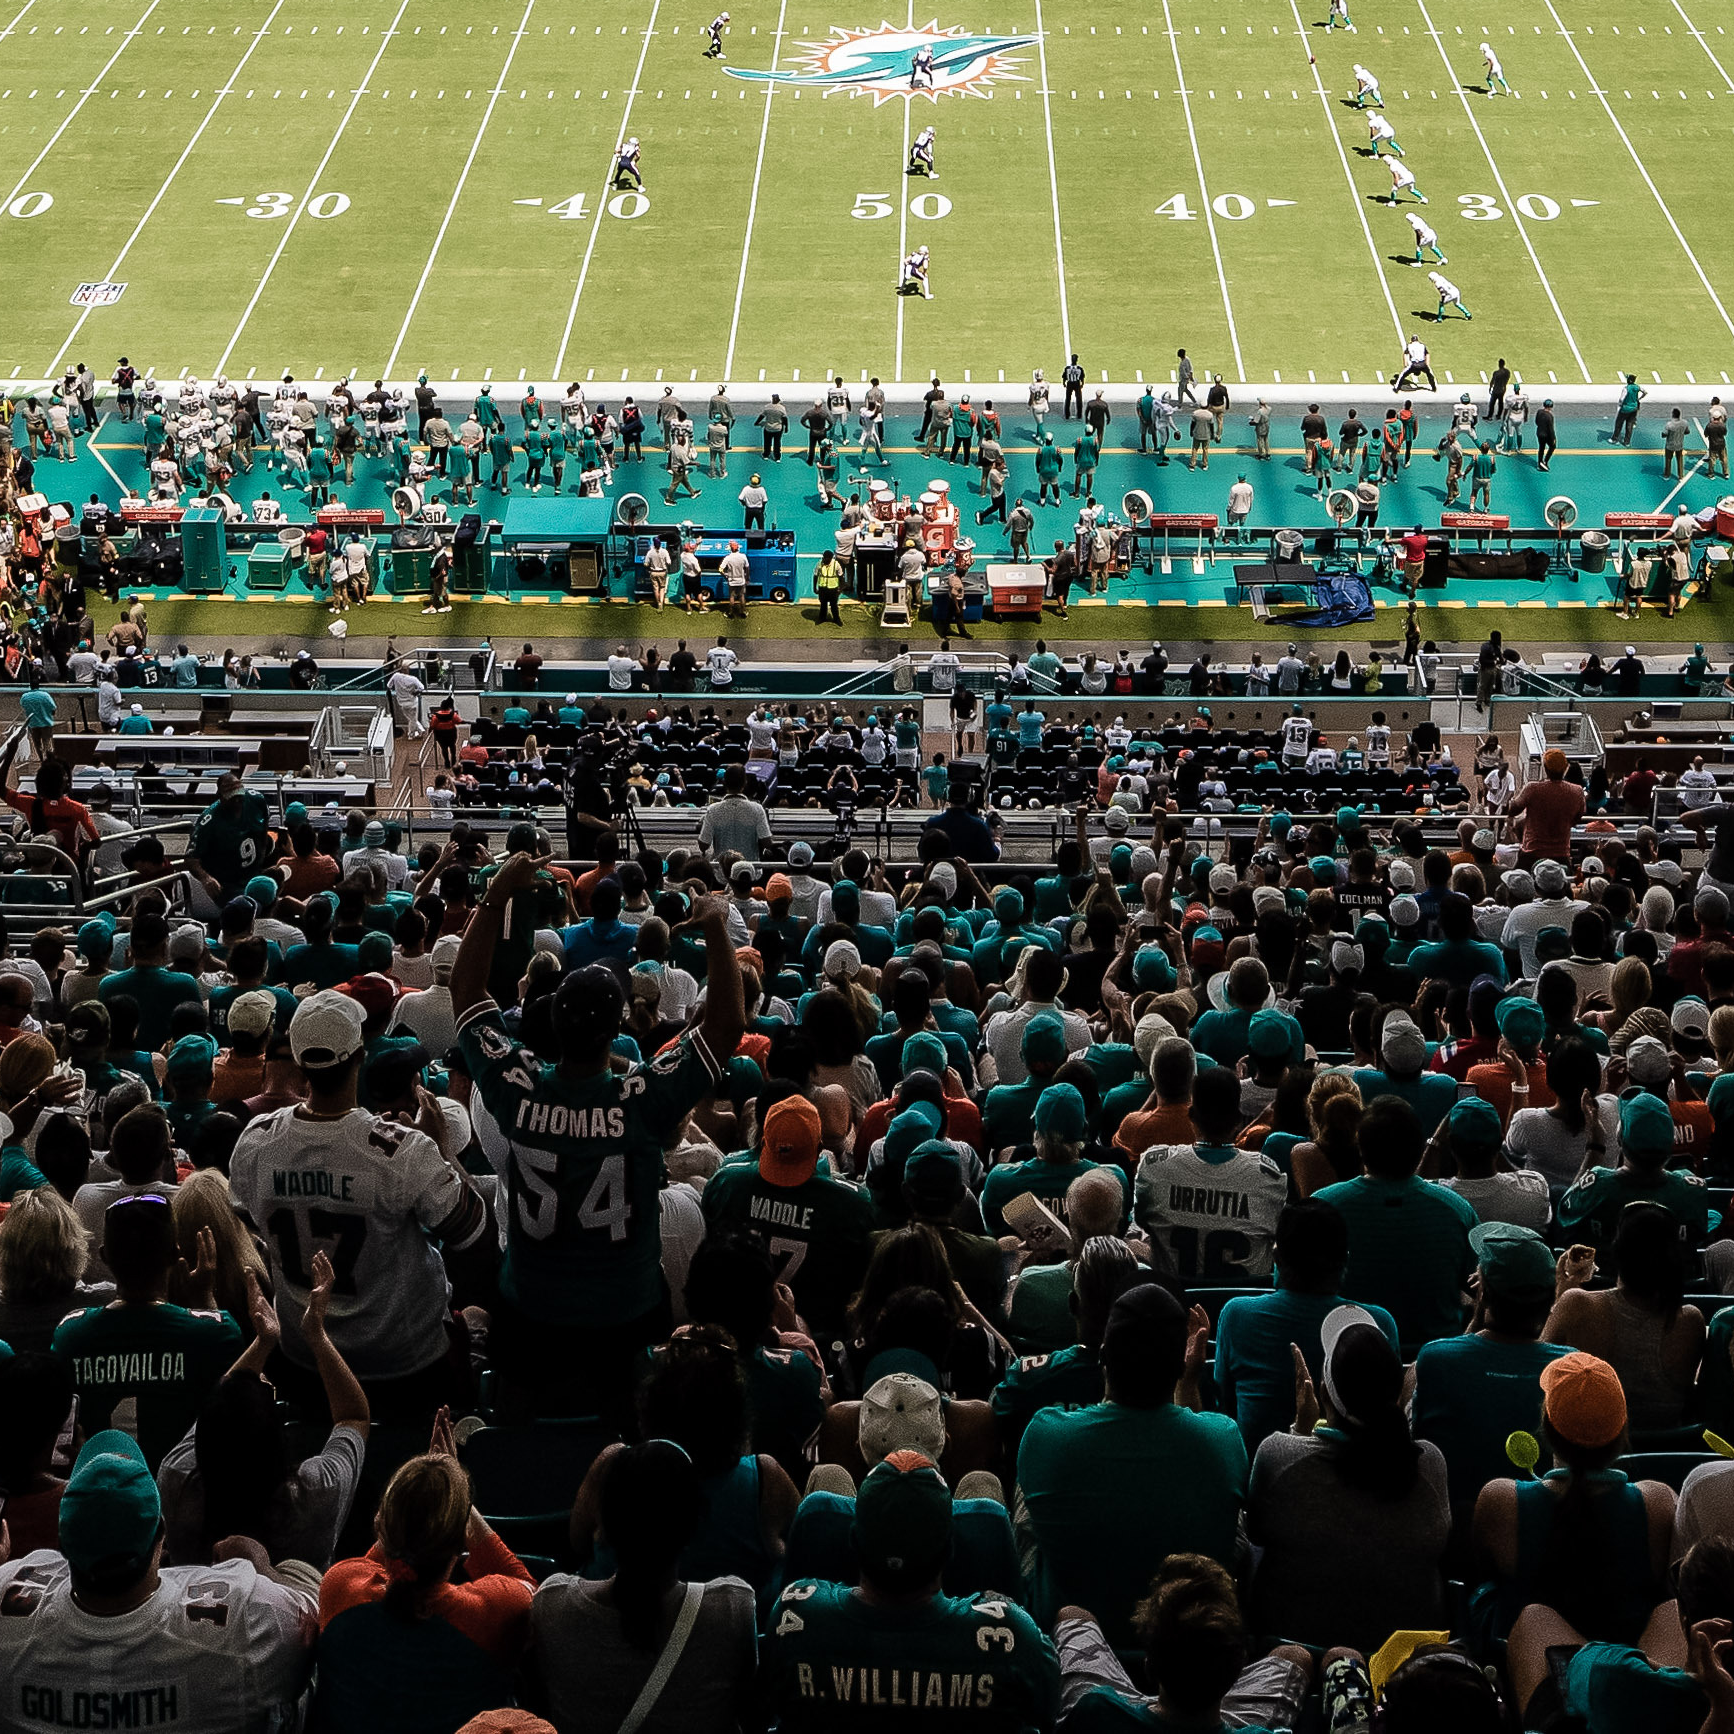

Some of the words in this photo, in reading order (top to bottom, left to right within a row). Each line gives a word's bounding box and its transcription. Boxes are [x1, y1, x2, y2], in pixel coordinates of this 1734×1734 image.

[245, 192, 352, 220] 30
[545, 192, 651, 221] 40
[849, 192, 953, 221] 50
[1153, 193, 1256, 221] 40
[1456, 193, 1562, 221] 30
[1339, 892, 1384, 906] EDELMAN
[516, 1099, 626, 1139] THOMAS
[272, 1170, 354, 1202] WADDLE
[511, 1146, 633, 1242] 54
[1169, 1185, 1250, 1219] URRUTIA
[750, 1195, 813, 1229] WADDLE
[267, 1210, 368, 1295] 17
[1169, 1226, 1252, 1278] 16
[72, 1352, 186, 1384] TAGOVAILOA
[21, 1684, 177, 1731] GOLDSMITH
